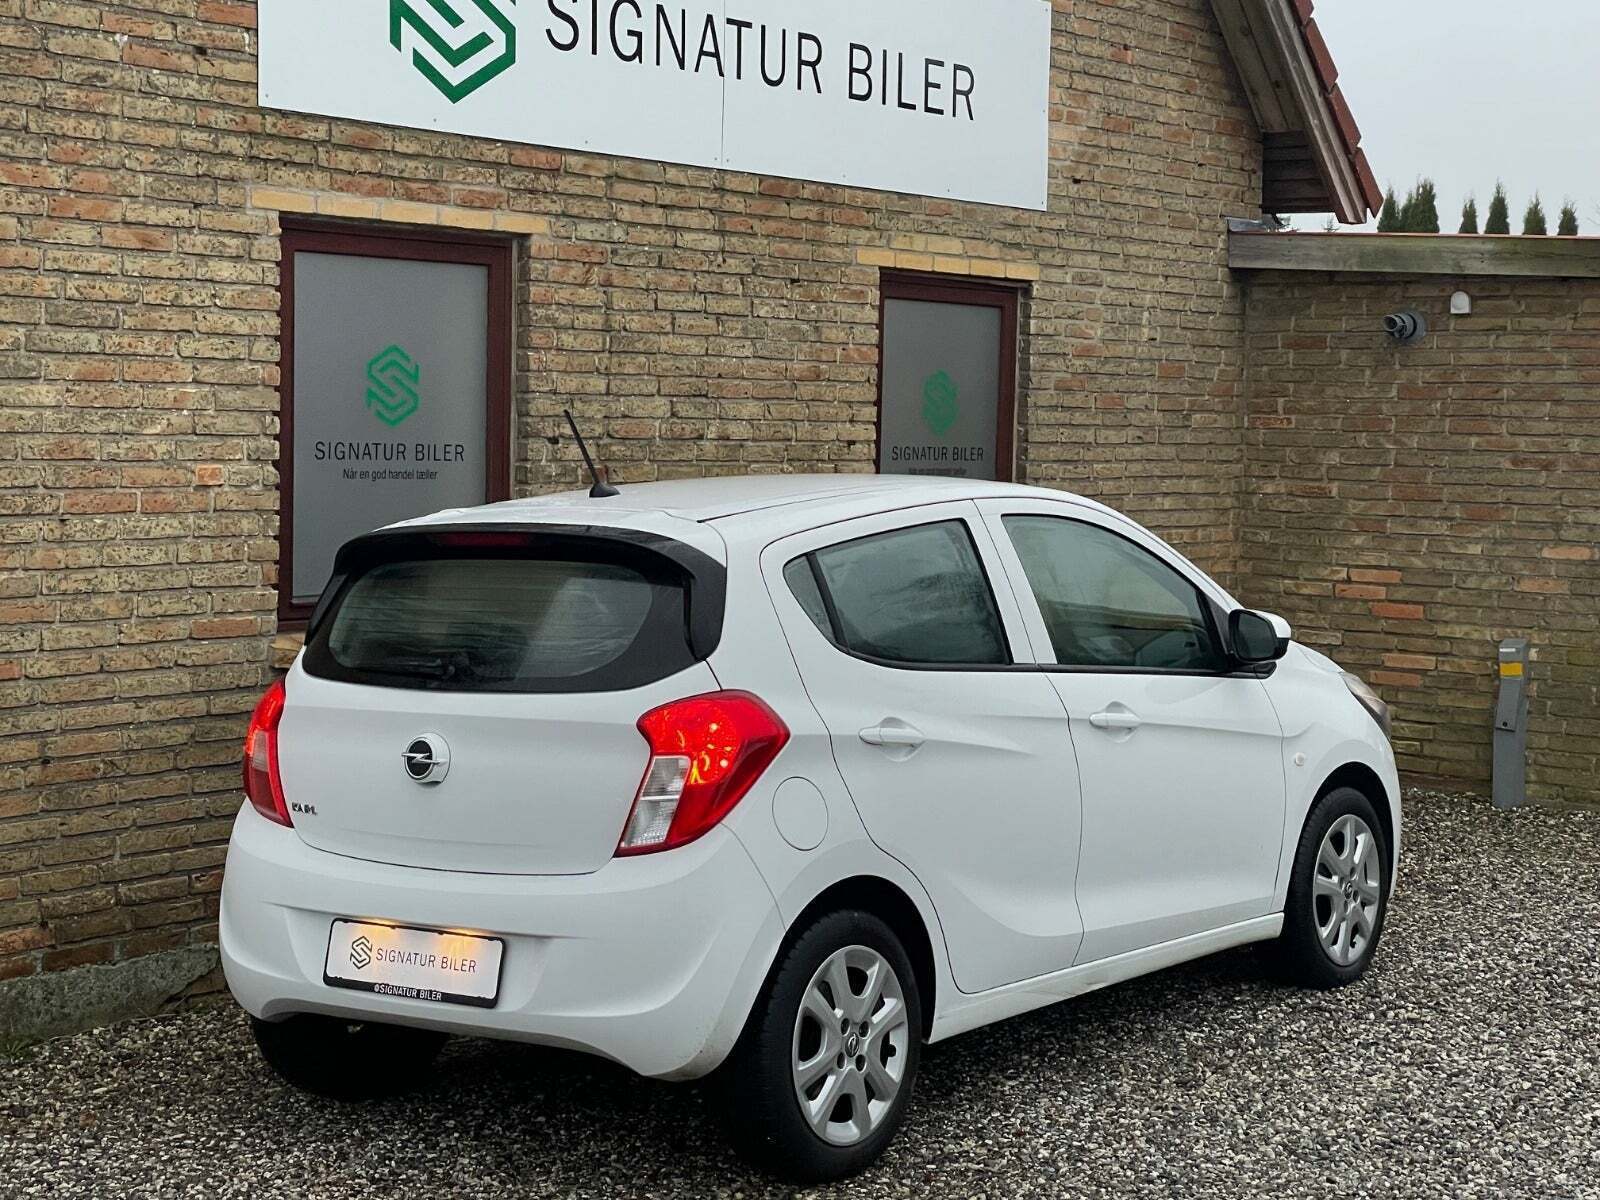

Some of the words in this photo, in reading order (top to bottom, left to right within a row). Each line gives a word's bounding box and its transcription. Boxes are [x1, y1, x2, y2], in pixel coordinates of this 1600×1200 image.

[545, 0, 823, 94] SIGNATUR
[848, 42, 975, 121] BILER
[314, 441, 407, 461] SIGNATUR
[415, 443, 465, 462] BILER
[891, 446, 948, 461] SIGNATUR
[952, 446, 984, 461] BILER
[342, 468, 358, 480] Når
[359, 470, 369, 480] en
[371, 468, 387, 482] god
[388, 468, 415, 480] handel
[416, 468, 438, 480] tæller
[375, 947, 436, 969] SIGNATUR
[440, 956, 477, 973] BILER
[419, 989, 442, 1001] BILER
